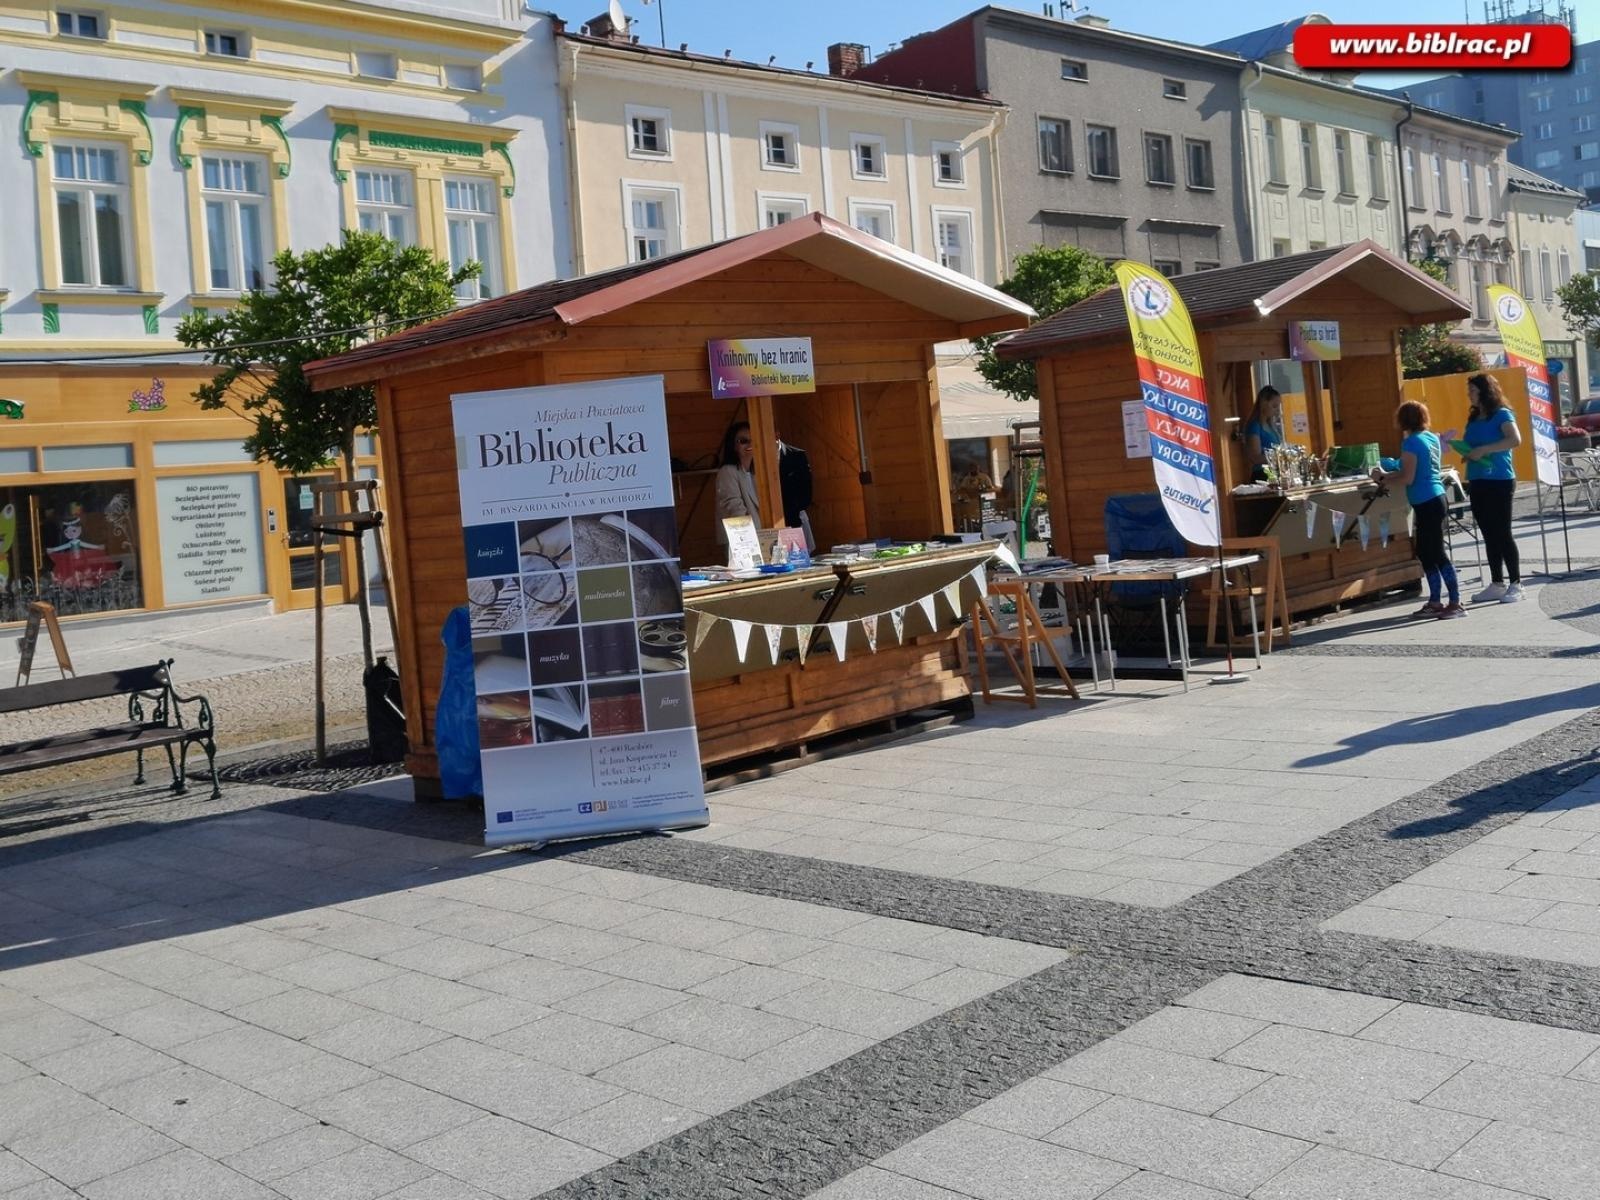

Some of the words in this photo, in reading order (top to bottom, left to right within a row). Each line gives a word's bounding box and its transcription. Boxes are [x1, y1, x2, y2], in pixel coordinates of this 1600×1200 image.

[717, 348, 759, 369] Knihovny
[761, 348, 777, 365] bez
[780, 347, 808, 364] hranic
[751, 373, 779, 385] Biblioteki
[780, 374, 790, 384] bez
[534, 408, 577, 425] Miejska
[580, 407, 585, 420] i
[587, 402, 646, 418] Powiatowa
[478, 422, 649, 468] Biblioteka
[548, 461, 638, 485] Publiczna
[200, 485, 229, 493] potraviny
[211, 493, 241, 501] potraviny
[500, 503, 549, 515] RYSZARDA
[539, 653, 570, 664] muzyka
